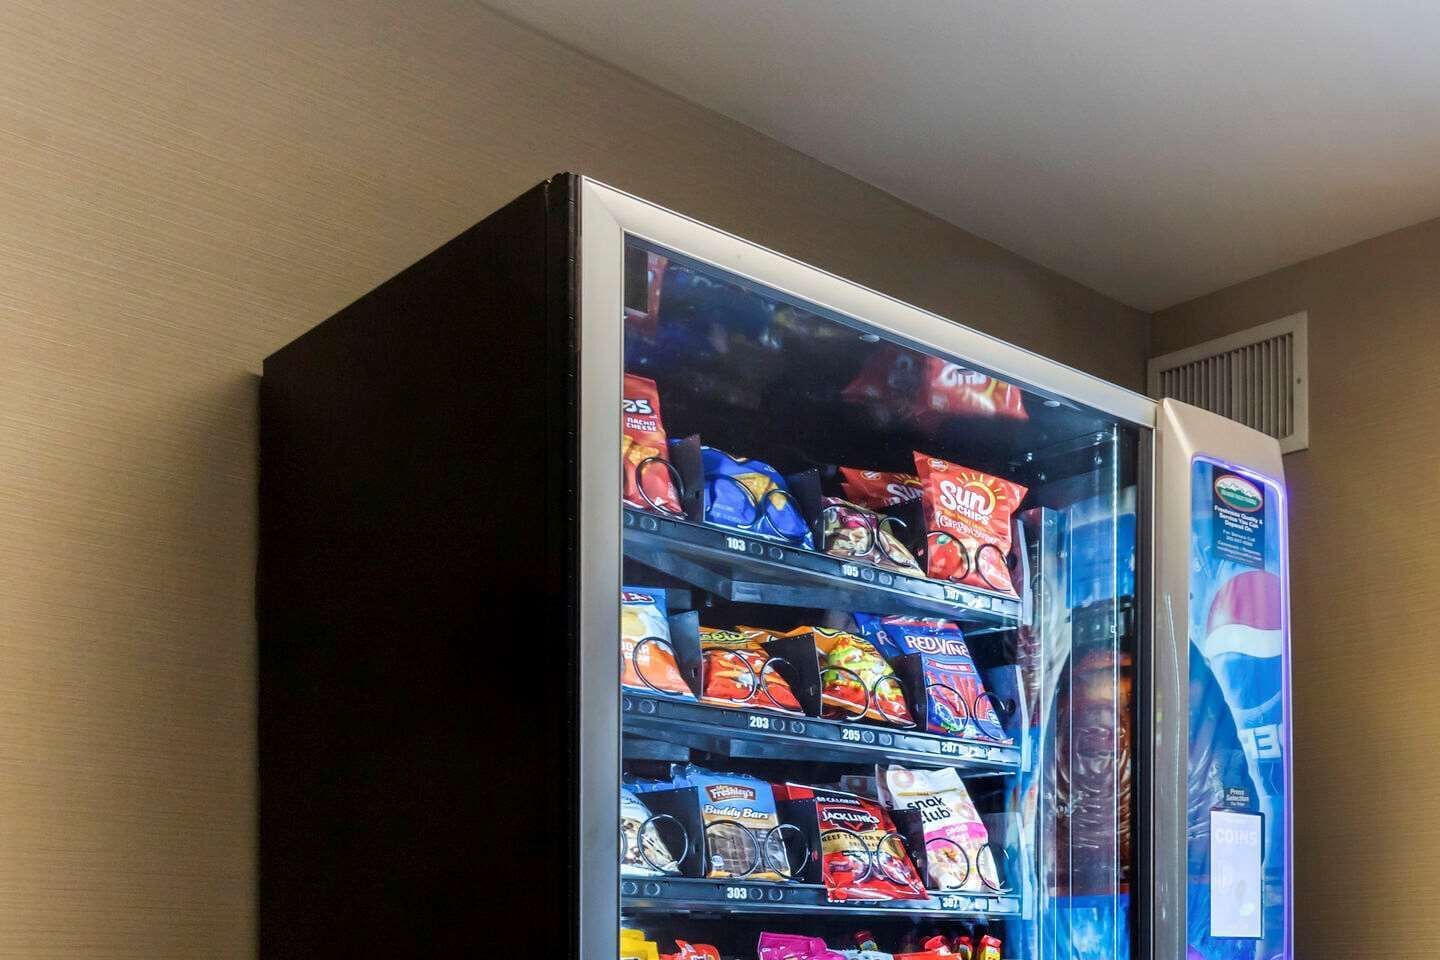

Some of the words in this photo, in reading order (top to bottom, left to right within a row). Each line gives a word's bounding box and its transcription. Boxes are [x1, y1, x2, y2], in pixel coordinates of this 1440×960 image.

[940, 480, 994, 516] Sun
[957, 504, 992, 525] CHIPS
[727, 536, 746, 551] 103
[843, 564, 859, 577] 105
[750, 716, 769, 729] 203
[842, 729, 861, 742] 205
[907, 796, 946, 810] snak
[703, 804, 741, 819] Buddy
[742, 808, 769, 819] Bars
[822, 810, 846, 822] JACK
[922, 808, 951, 824] lub
[727, 887, 748, 899] 303
